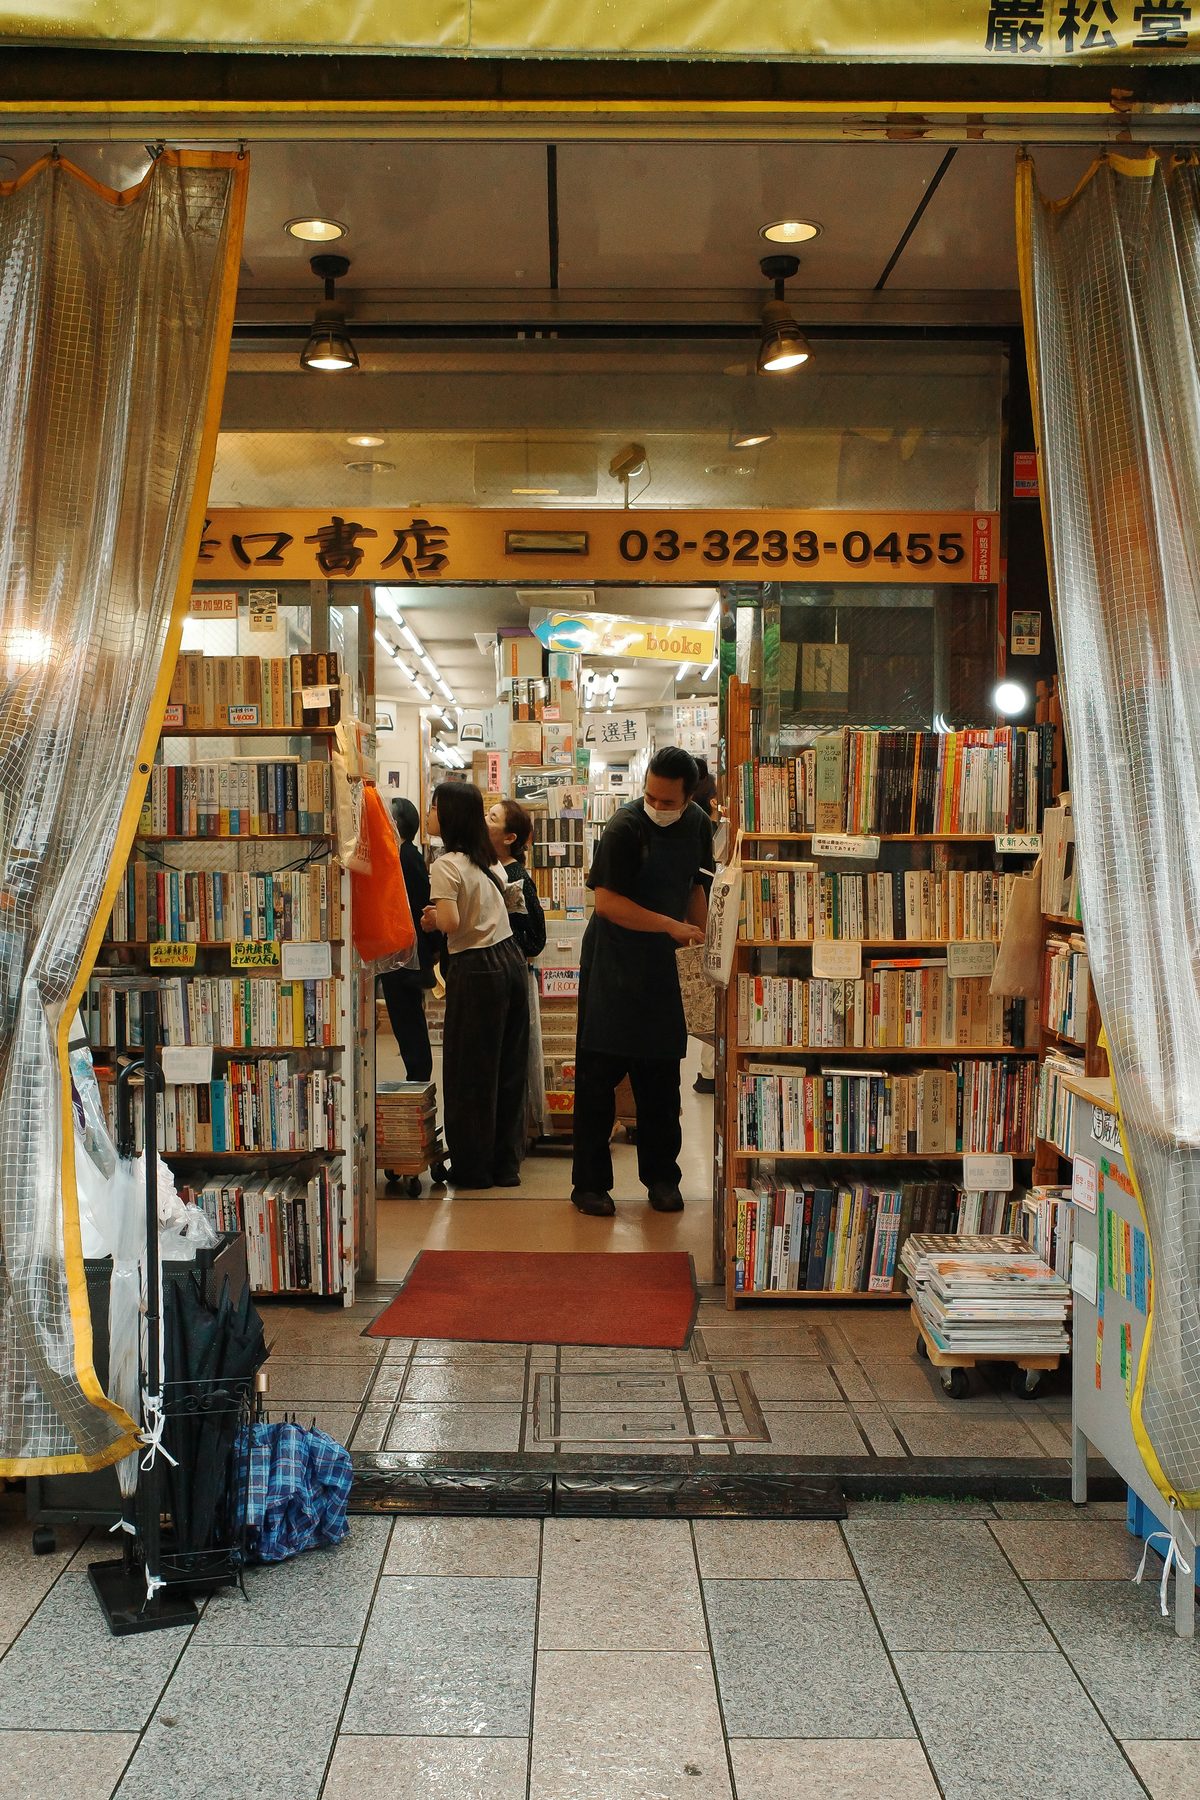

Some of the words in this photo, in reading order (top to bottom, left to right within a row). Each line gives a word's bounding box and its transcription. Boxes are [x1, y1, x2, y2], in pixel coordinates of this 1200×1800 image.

[619, 529, 966, 566] 03-3233-0455
[190, 599, 233, 611] 連加盟店
[647, 632, 702, 656] books
[601, 719, 637, 743] 選書
